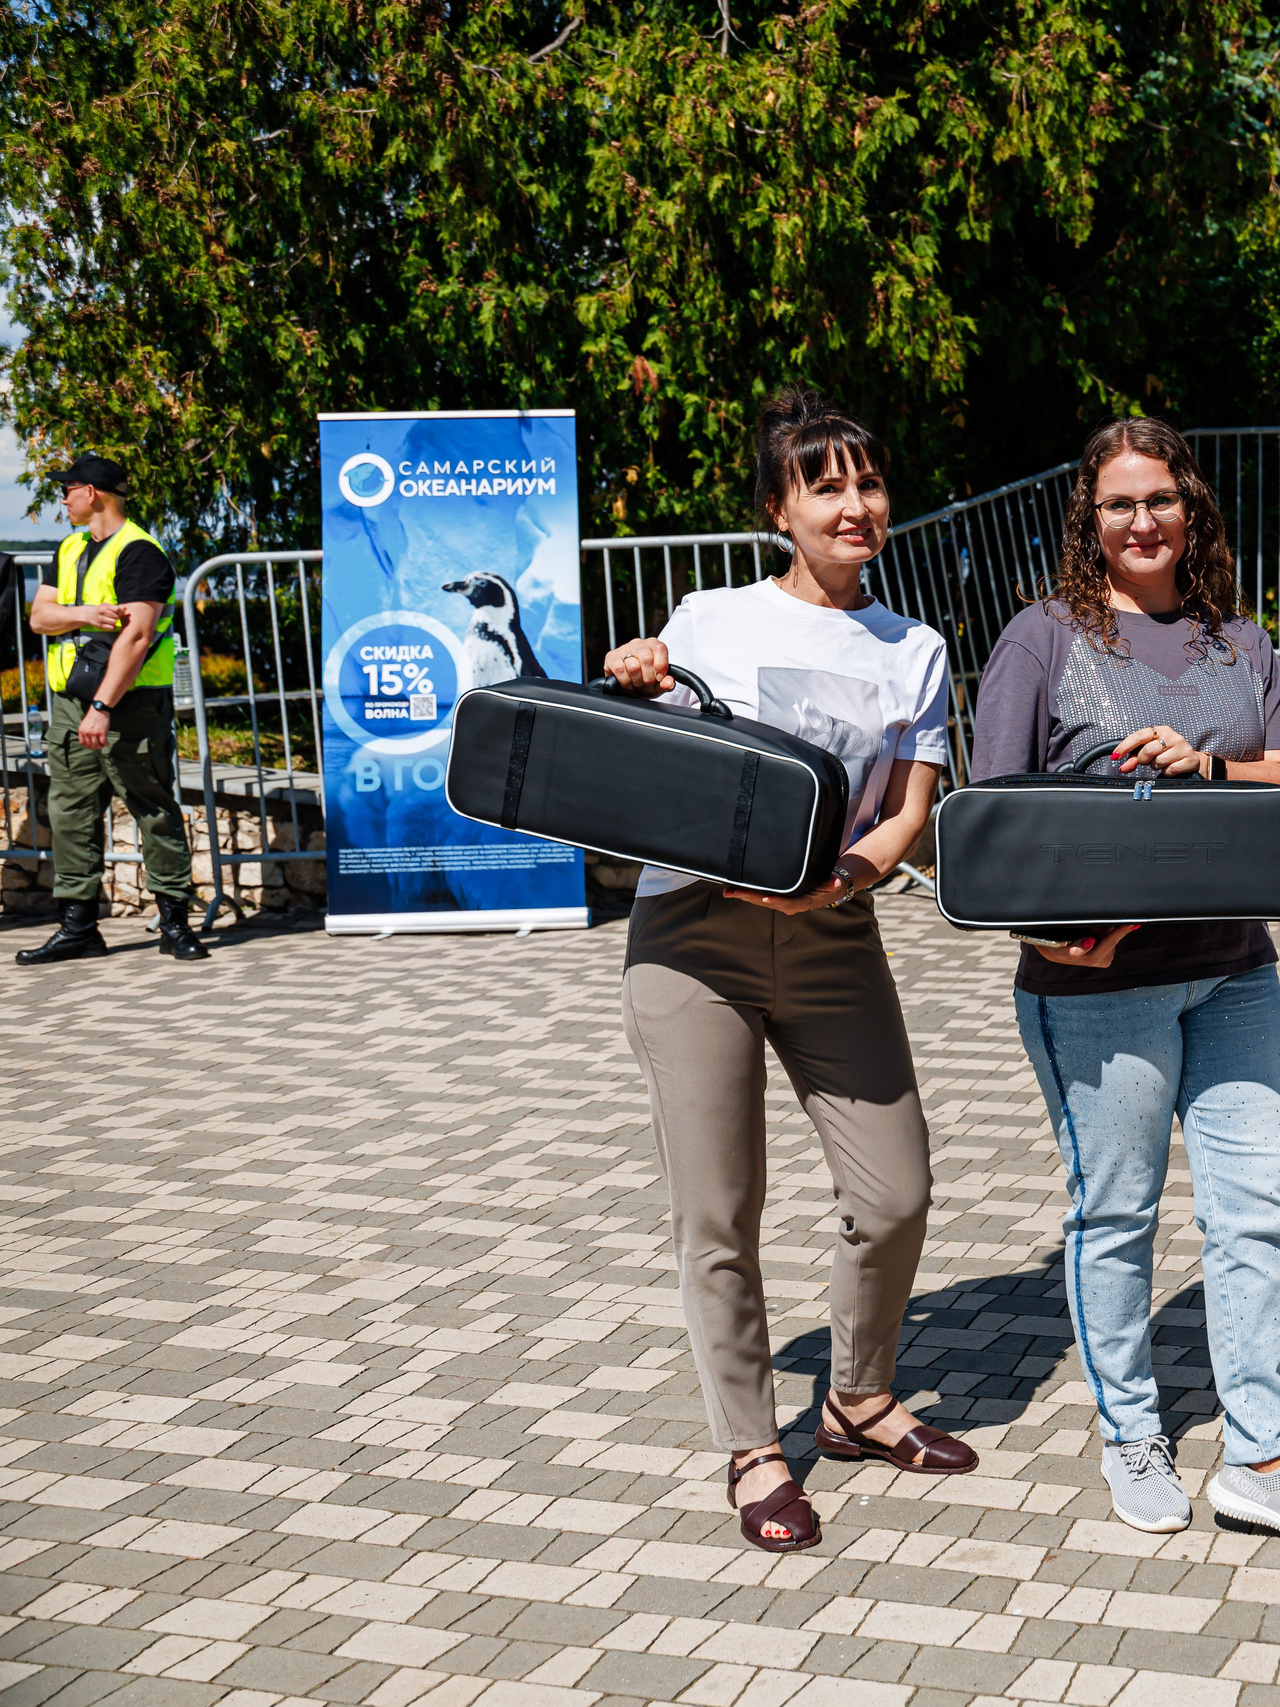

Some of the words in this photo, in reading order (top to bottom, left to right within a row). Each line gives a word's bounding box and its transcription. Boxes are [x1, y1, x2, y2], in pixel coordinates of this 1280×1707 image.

[399, 456, 556, 476] САМАРСКИЙ
[399, 478, 556, 497] ОКЕАНАРИУМ
[360, 644, 434, 662] СКИДКА
[362, 662, 434, 696] 15%
[365, 708, 409, 719] ВОЛНА
[356, 759, 381, 792] В
[1040, 843, 1227, 865] TENET
[1226, 1469, 1270, 1505] FASHION
